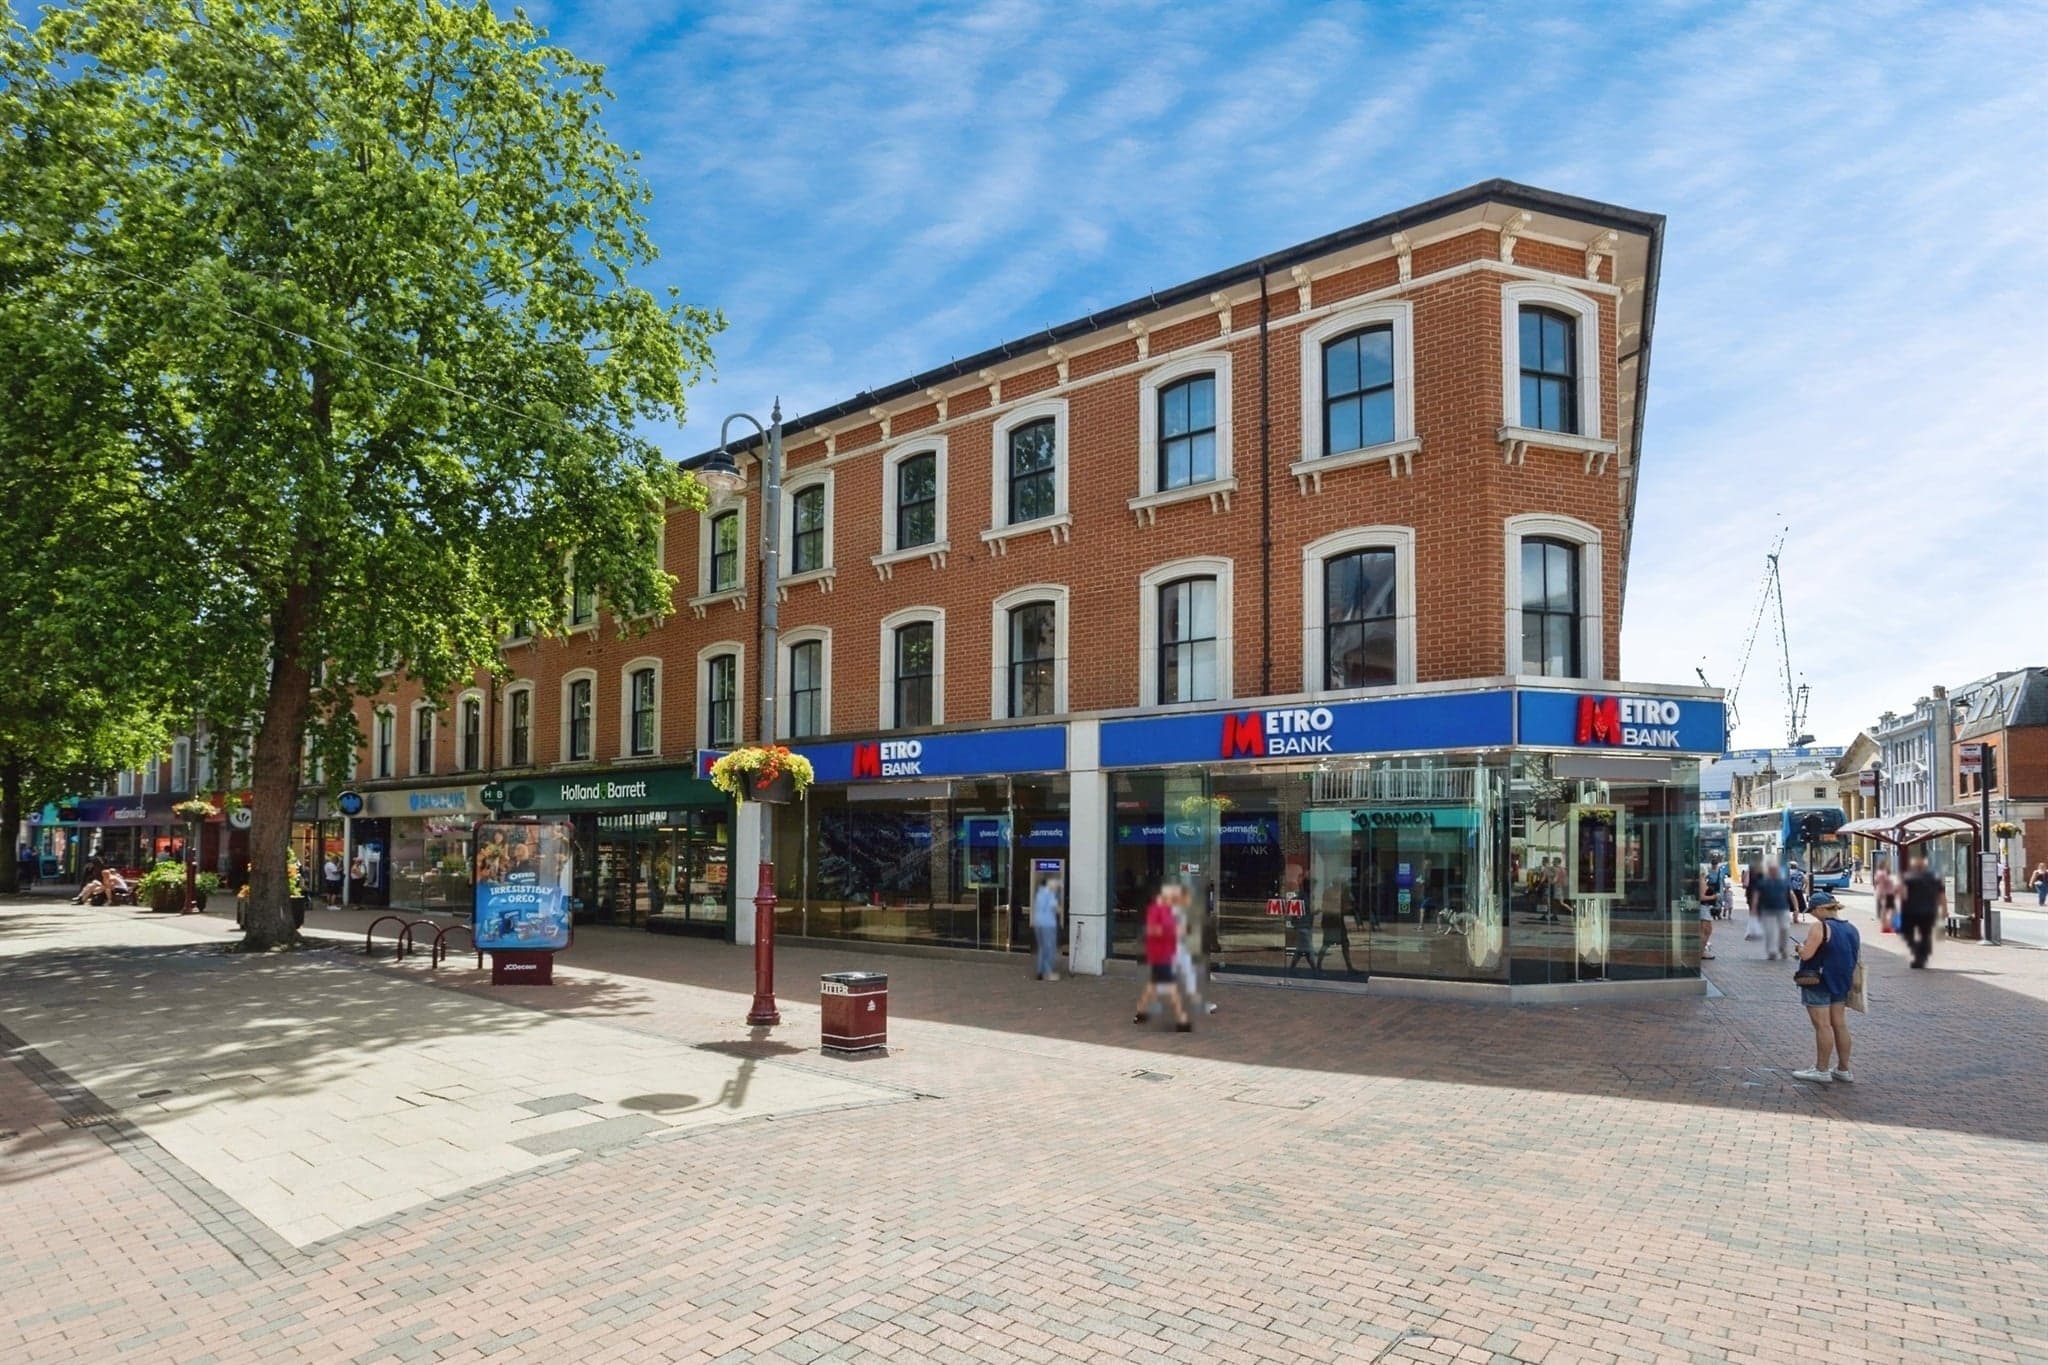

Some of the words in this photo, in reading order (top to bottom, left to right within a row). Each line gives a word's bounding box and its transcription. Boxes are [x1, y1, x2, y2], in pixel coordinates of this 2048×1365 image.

[1577, 695, 1680, 744] METRO
[1223, 708, 1333, 757] METRO
[1623, 727, 1680, 747] BANK
[1268, 735, 1332, 754] BANK
[853, 740, 922, 778] METRO
[882, 761, 922, 776] BANK
[561, 783, 600, 800] Holland
[608, 781, 646, 798] Barrett
[491, 885, 553, 895] IRRESISTIBLY
[508, 894, 535, 903] OREO
[821, 982, 849, 996] LITTER
